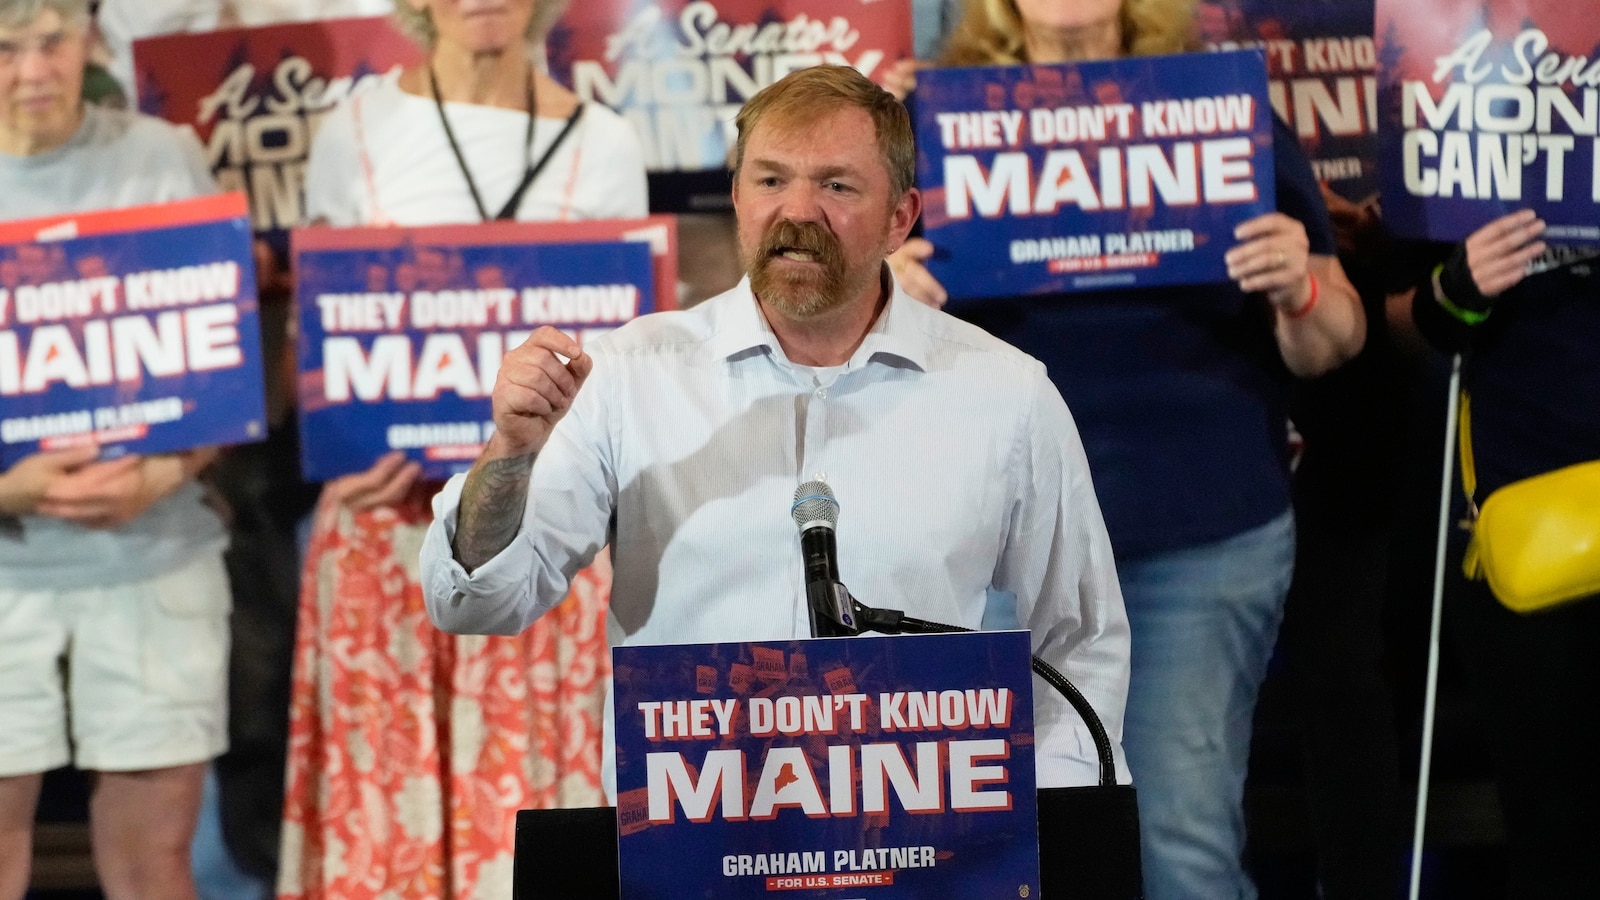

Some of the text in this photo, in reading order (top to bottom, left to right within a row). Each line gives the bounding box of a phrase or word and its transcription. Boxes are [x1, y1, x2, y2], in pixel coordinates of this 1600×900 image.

[677, 1, 860, 57] Senator
[1303, 35, 1375, 73] KNO
[1433, 28, 1493, 82] A
[197, 62, 259, 124] A
[1402, 81, 1600, 134] MON
[937, 110, 1022, 148] THEY
[1029, 104, 1134, 145] DON'T
[1142, 94, 1252, 138] KNOW
[943, 138, 1255, 218] MAINE
[1403, 130, 1574, 201] CAN'T
[1010, 229, 1194, 263] GRAHAM PLATNER
[15, 275, 119, 323] DON'T
[124, 260, 238, 310] KNOW
[316, 283, 637, 332] THEY DON'T KNOW
[0, 303, 243, 394] AINE
[638, 688, 1009, 738] THEY DON'T KNOW
[646, 739, 1009, 821] MAINE
[722, 846, 936, 877] GRAHAM PLATNER
[777, 879, 802, 888] FOR
[806, 877, 830, 887] U.S.
[833, 874, 882, 886] SENATE
